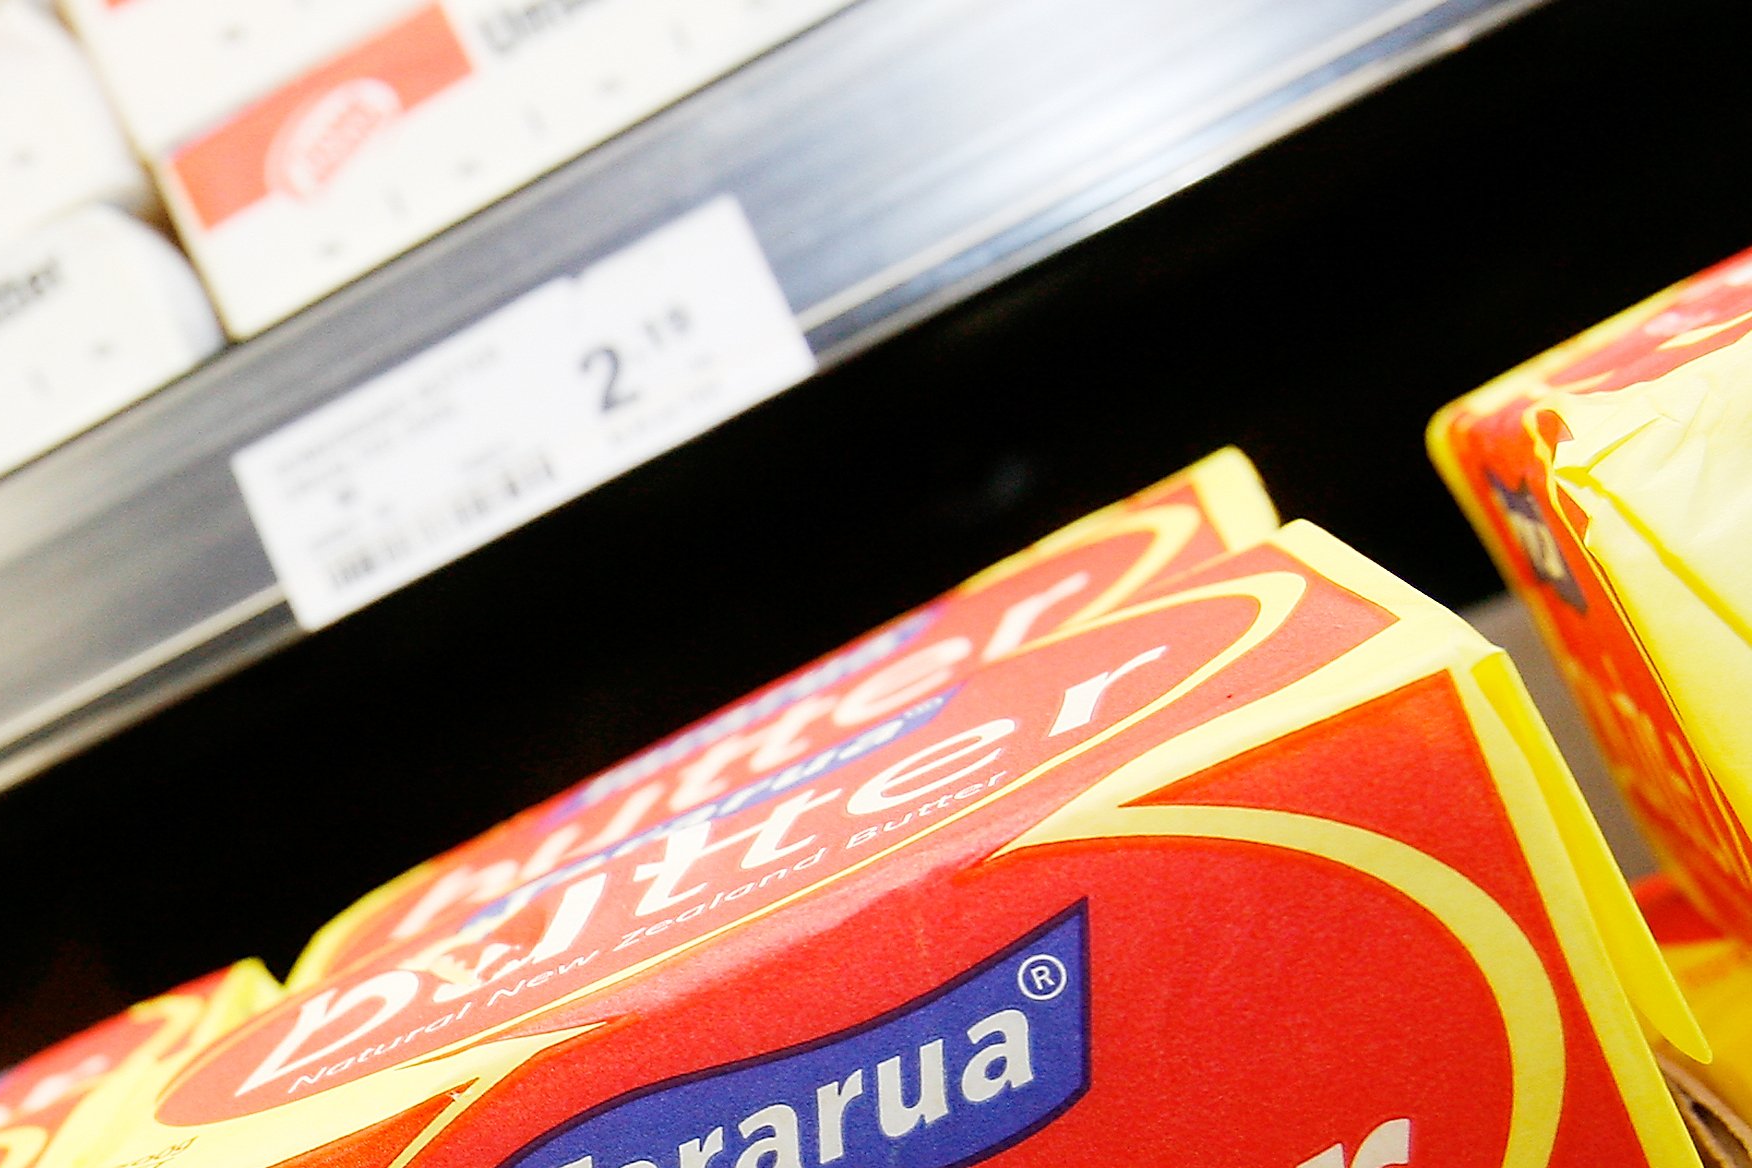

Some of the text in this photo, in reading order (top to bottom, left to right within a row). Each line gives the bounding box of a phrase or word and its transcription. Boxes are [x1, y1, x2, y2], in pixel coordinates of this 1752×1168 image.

[579, 345, 641, 412] 2
[288, 769, 1008, 1094] Natural New Zealand Butter
